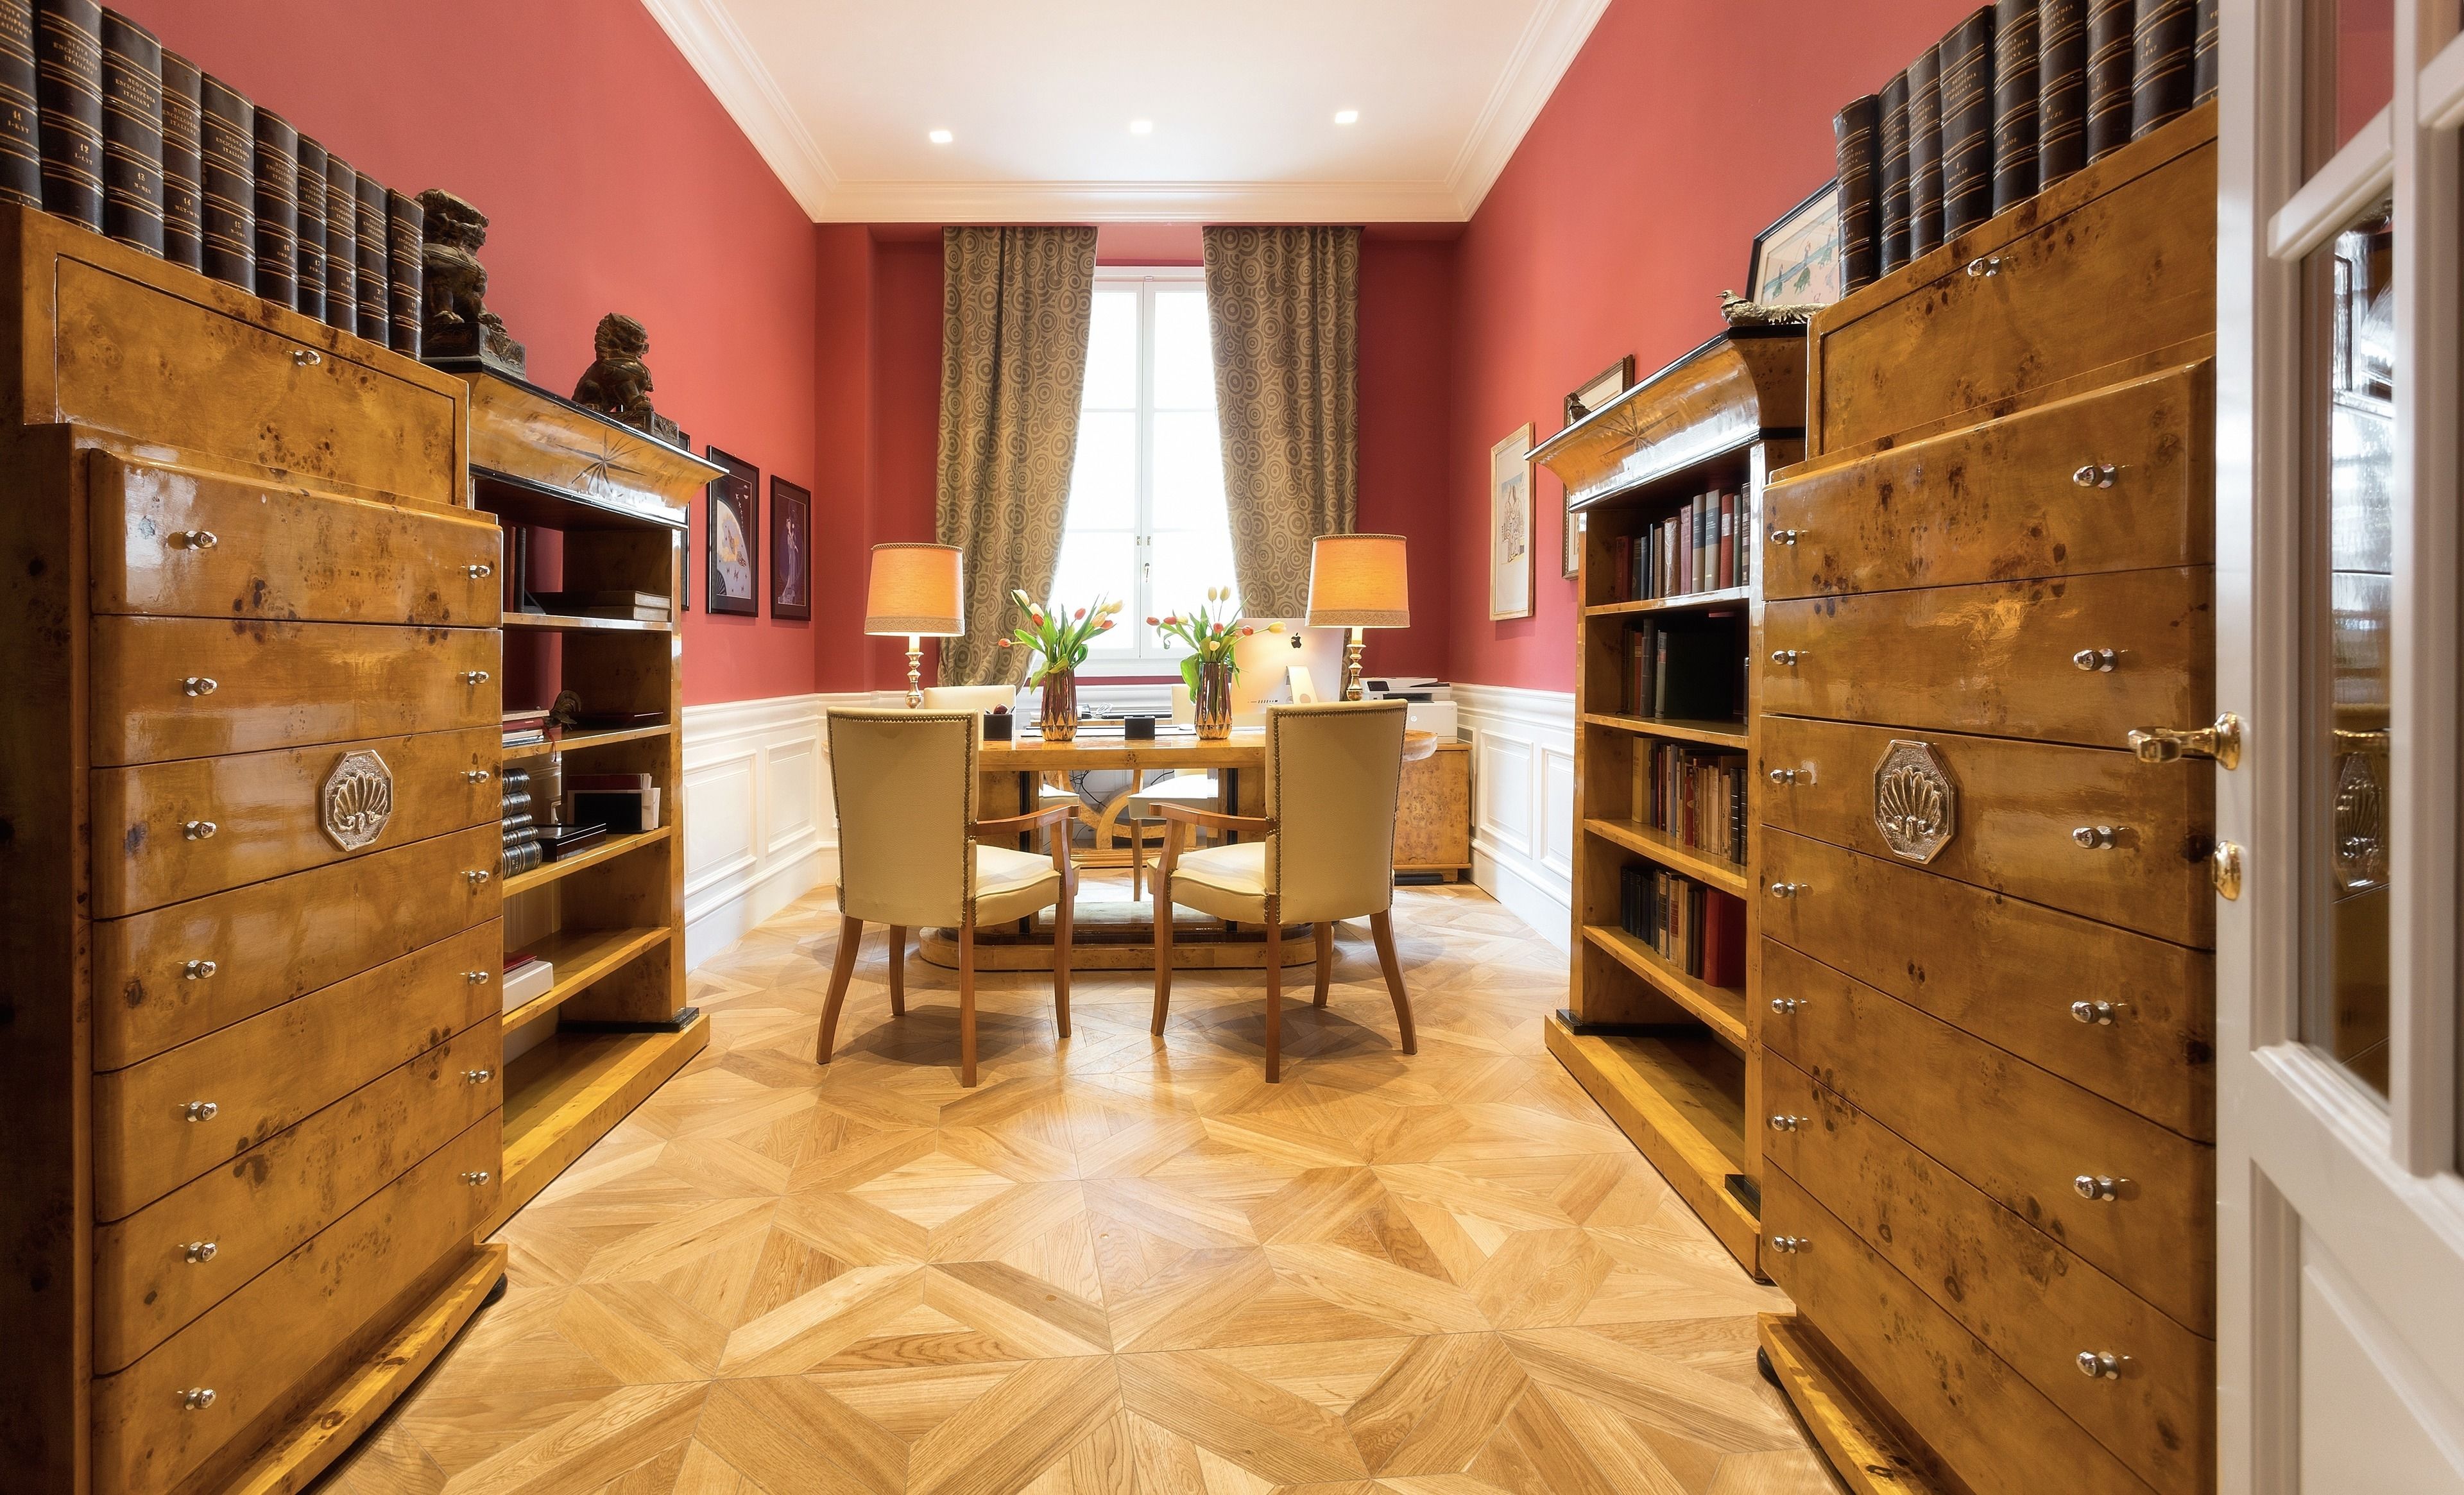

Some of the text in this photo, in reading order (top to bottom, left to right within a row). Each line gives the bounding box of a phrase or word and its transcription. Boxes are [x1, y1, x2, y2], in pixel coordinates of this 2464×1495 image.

[2096, 73, 2100, 83] 7
[128, 78, 147, 92] NUOVA
[115, 78, 156, 104] ENCICLOPEDIA
[123, 90, 151, 109] ITALIANA
[174, 107, 193, 121] NUOVA
[2046, 104, 2051, 114] 6
[12, 110, 21, 121] 11
[162, 109, 201, 133] ENCICLOPEDIA
[170, 119, 197, 137] ITALIANA
[226, 135, 243, 148] NUOVA
[2003, 132, 2008, 141] 5
[80, 143, 89, 153] 12
[223, 146, 246, 162] ITALIANA
[137, 172, 146, 182] 13
[184, 197, 191, 206] 14
[235, 220, 242, 229] 15
[315, 259, 321, 267] 17
